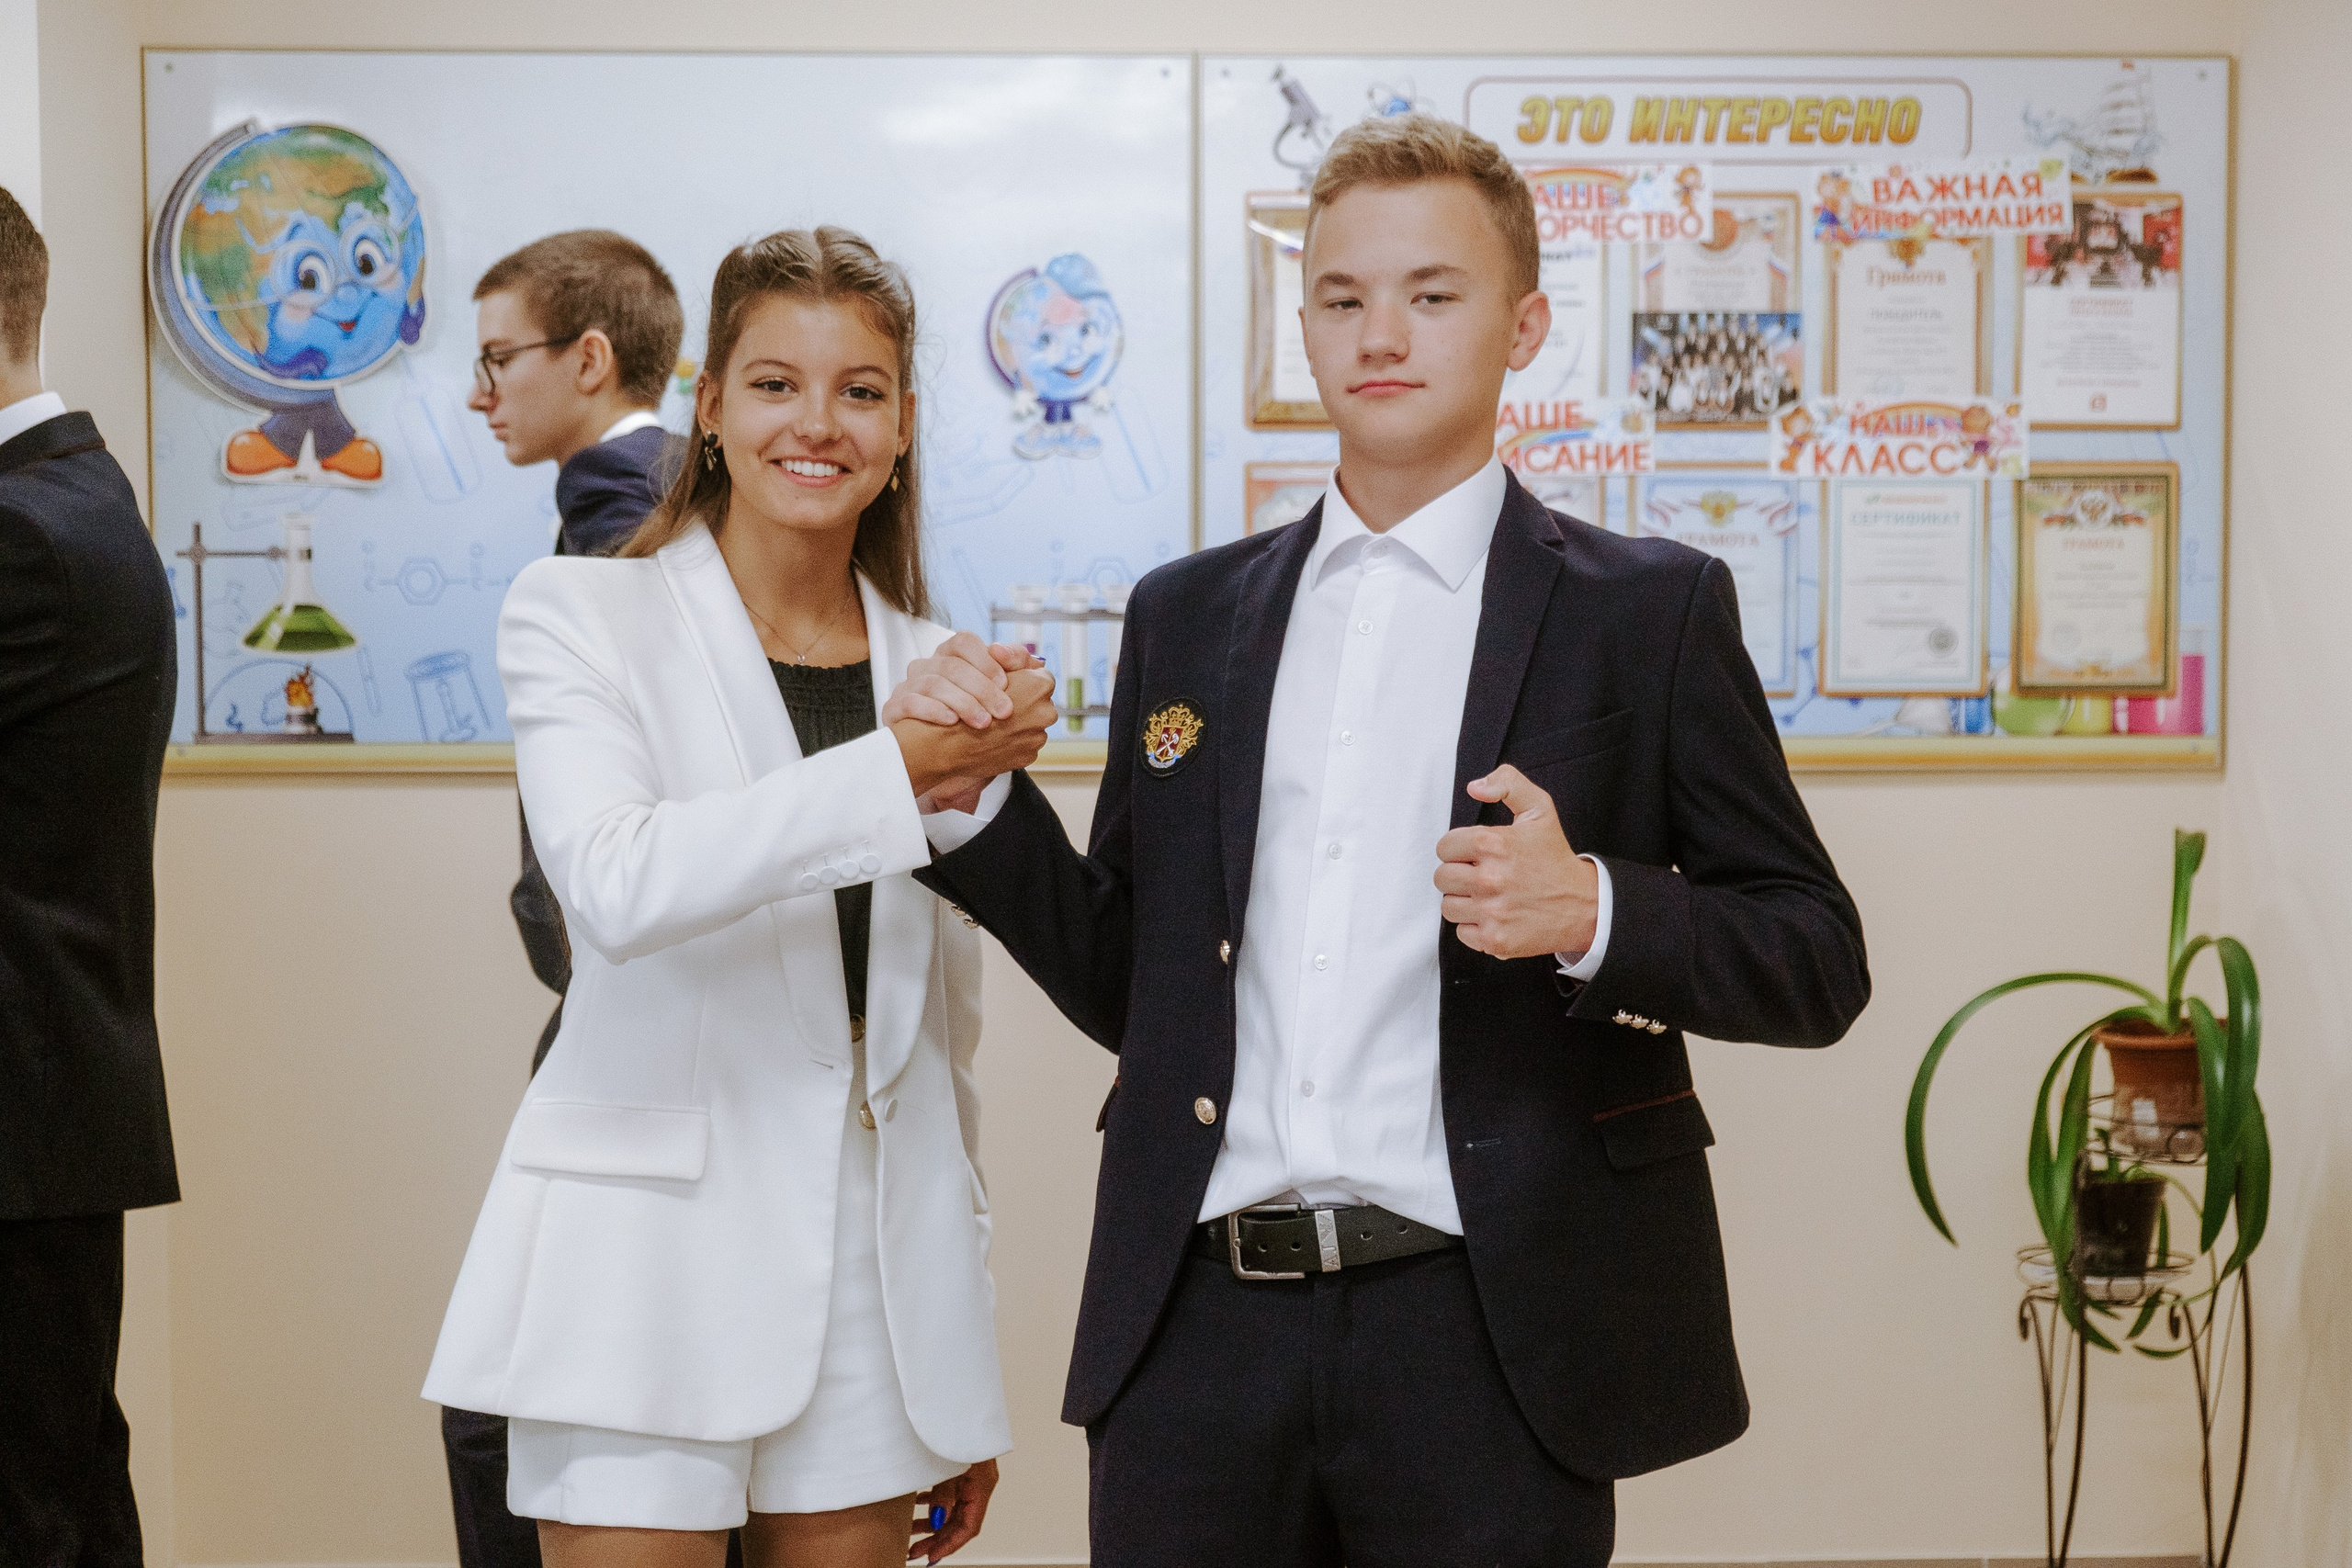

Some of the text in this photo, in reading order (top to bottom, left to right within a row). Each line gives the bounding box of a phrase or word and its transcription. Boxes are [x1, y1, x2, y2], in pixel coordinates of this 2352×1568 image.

[1517, 96, 1922, 145] ЭТО ИНТЕРЕСНО
[1532, 182, 1613, 210] АШЕ
[1872, 172, 2043, 204] ВАЖНАЯ
[1537, 212, 1704, 243] ОРЧЕСТВО
[1850, 204, 2064, 231] ИНФОРМАЦИЯ
[1496, 400, 1583, 430] АШЕ
[1815, 443, 1960, 475] КЛАСС
